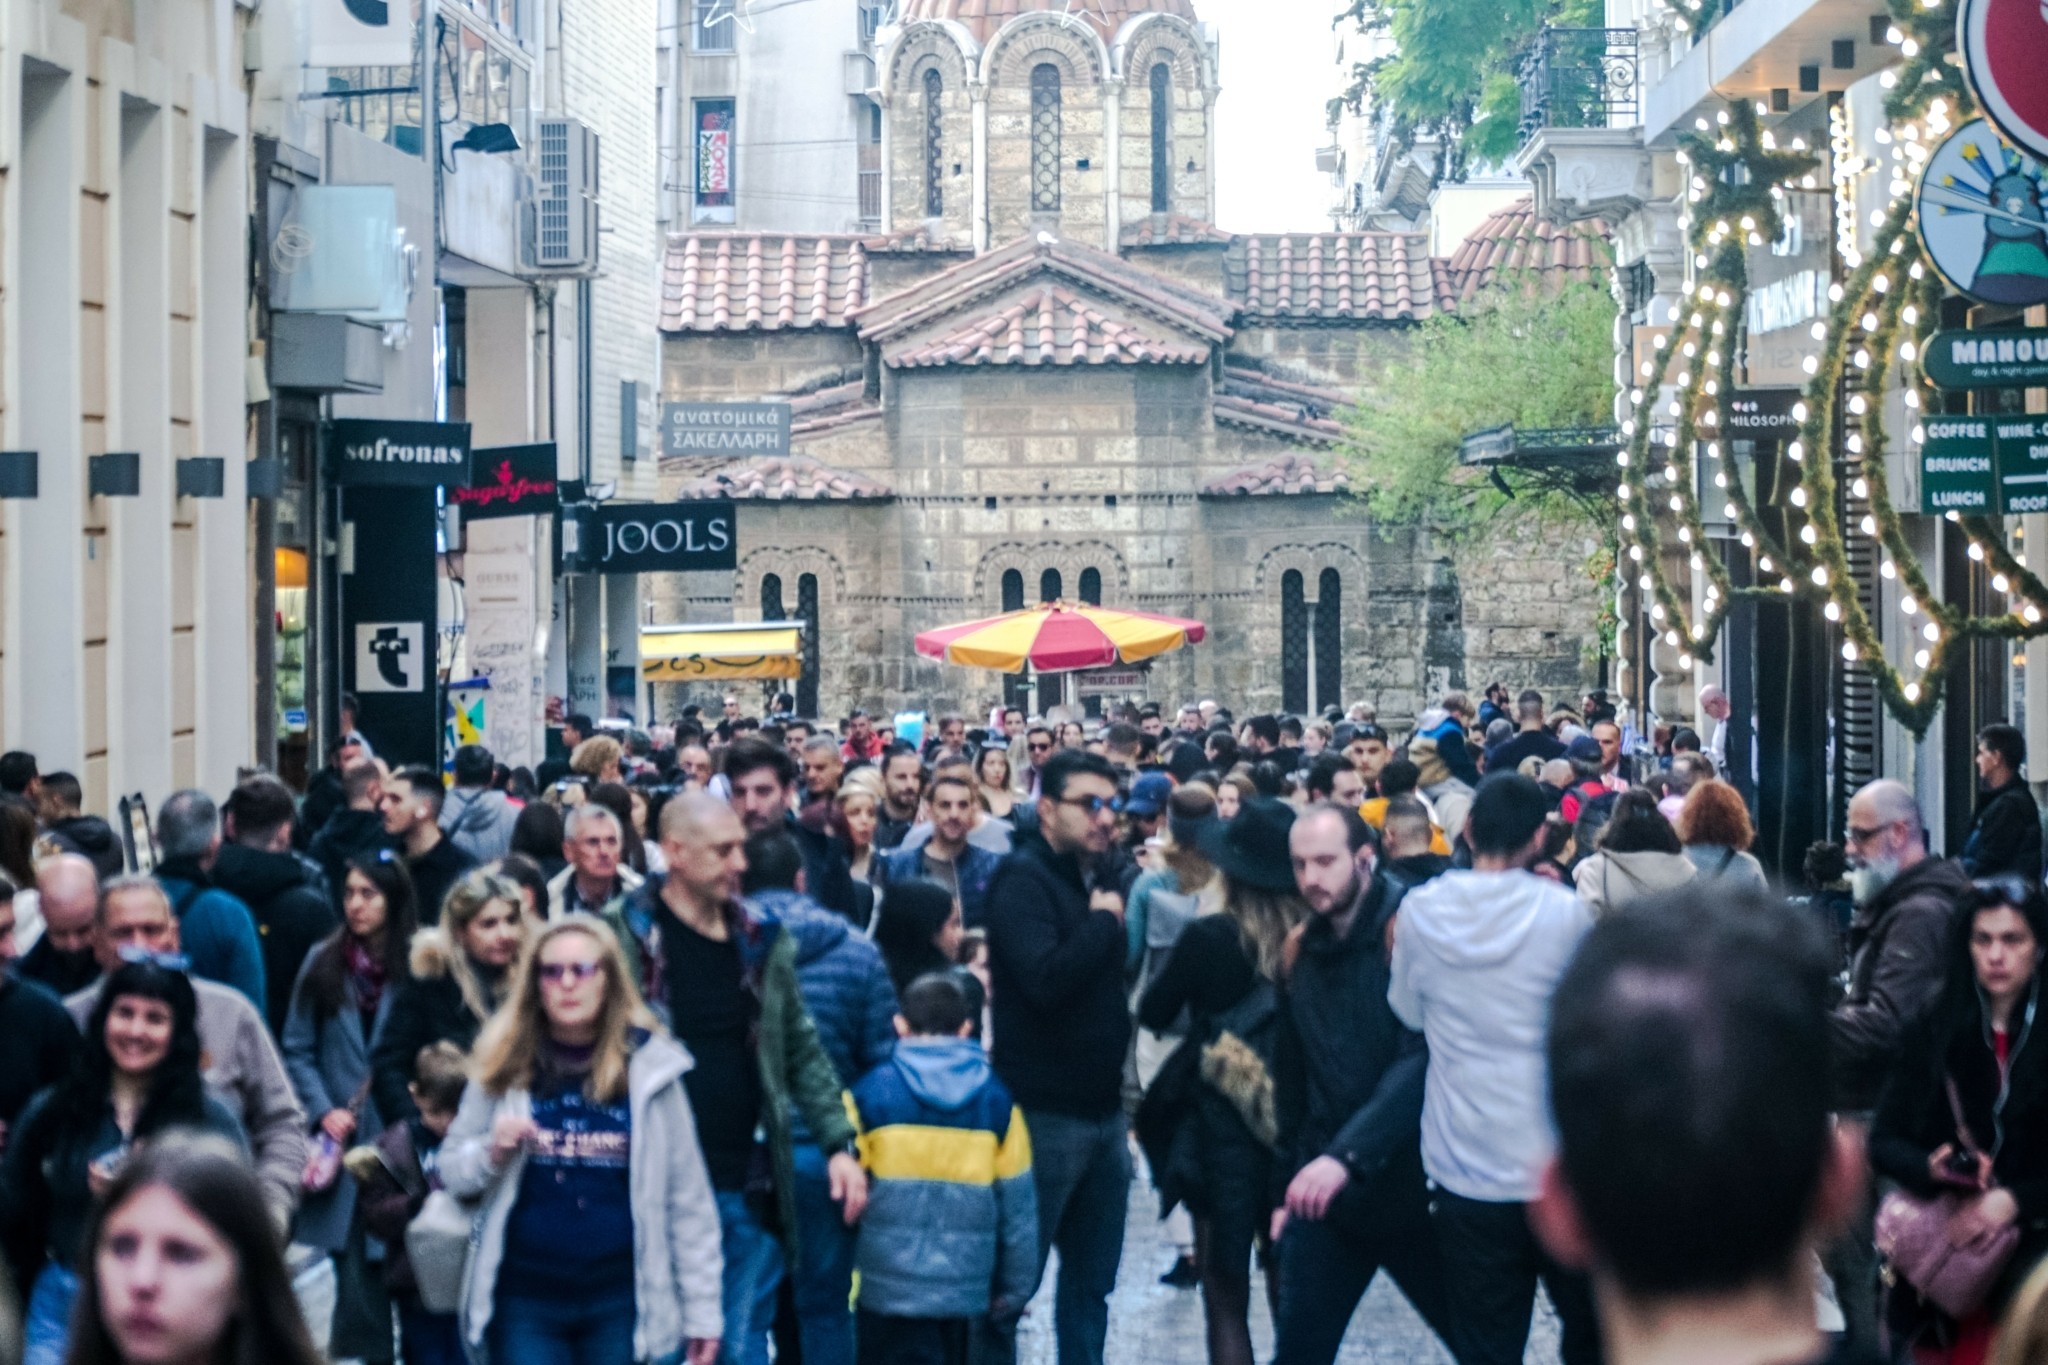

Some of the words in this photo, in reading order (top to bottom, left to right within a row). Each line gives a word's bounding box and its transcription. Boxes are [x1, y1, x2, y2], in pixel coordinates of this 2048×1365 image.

[673, 407, 780, 428] ανατομικά
[1928, 422, 1987, 439] COFFEE
[673, 432, 780, 449] ΣΑΚΕΛΛΑΡΗ
[344, 437, 463, 464] sofronas
[1925, 457, 1990, 473] BRUNCH
[1931, 491, 1985, 507] LUNCH
[602, 518, 729, 562] JOOLS
